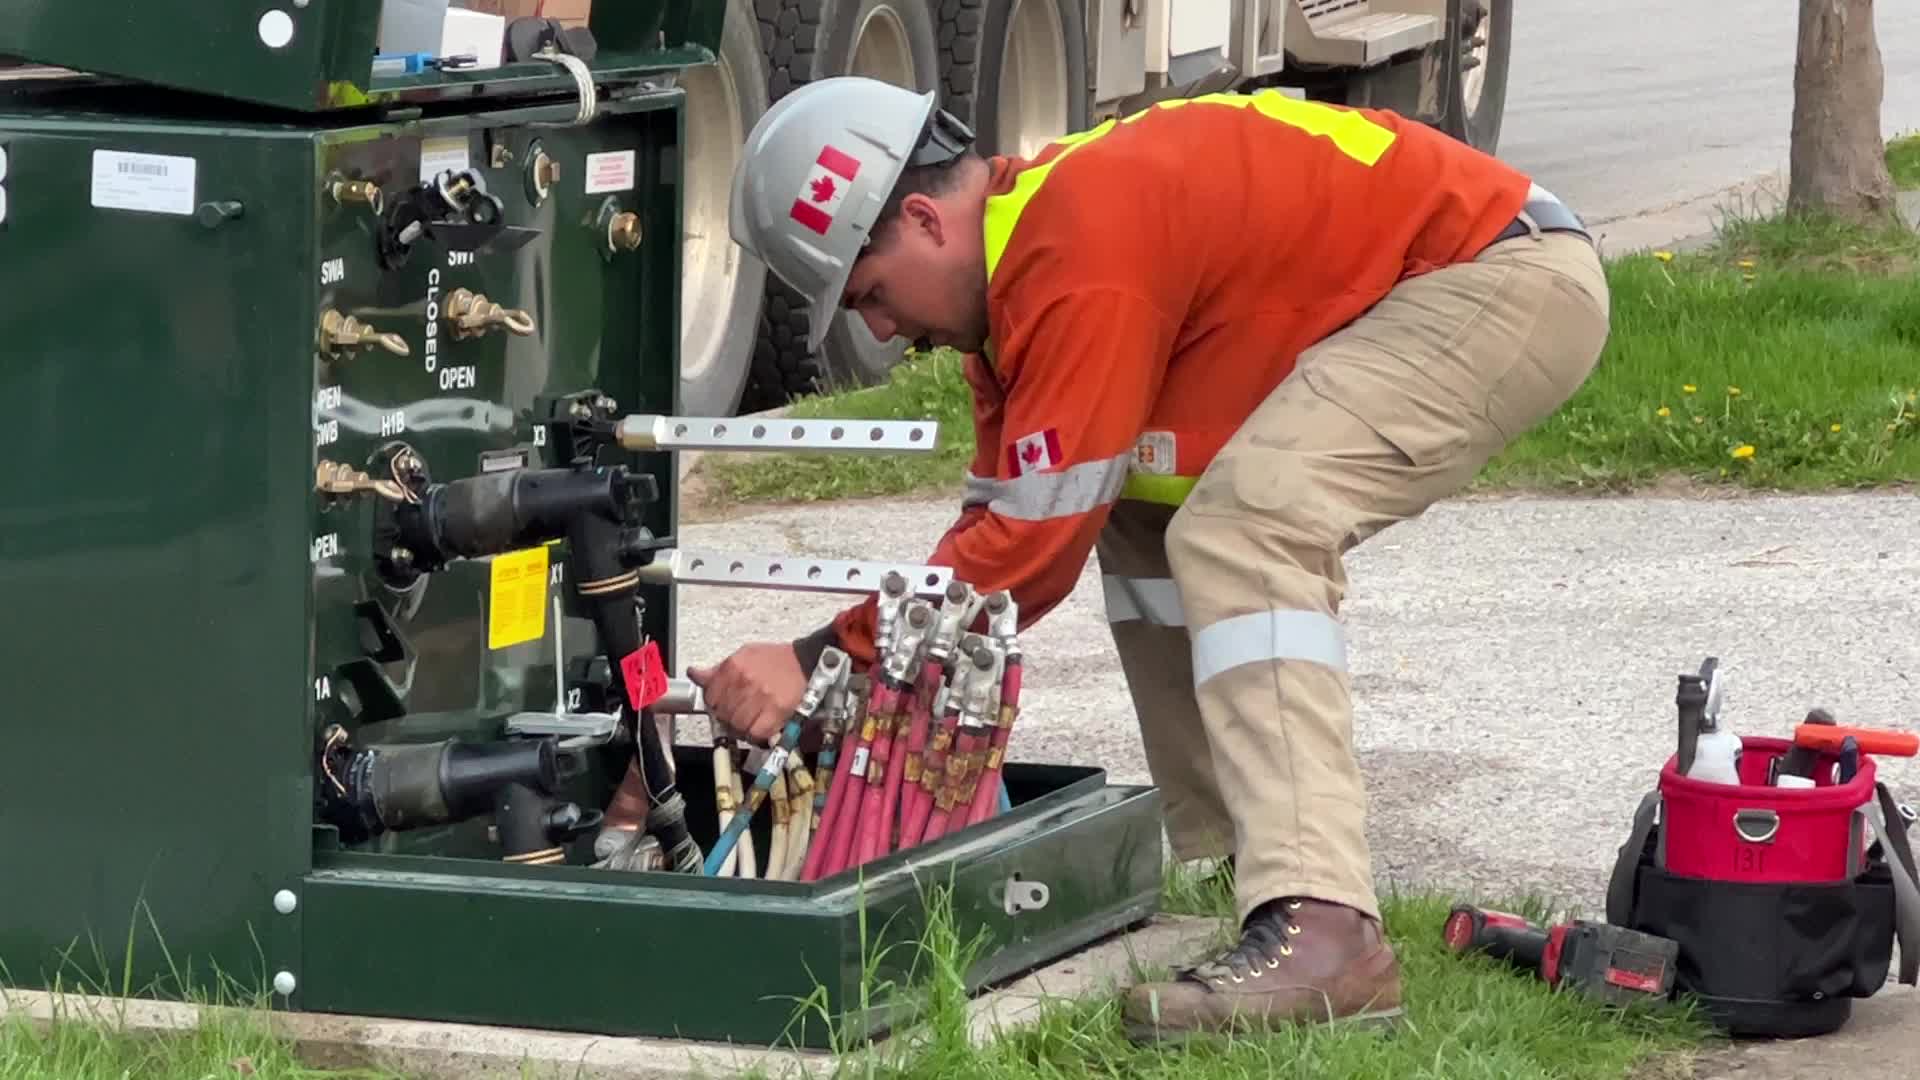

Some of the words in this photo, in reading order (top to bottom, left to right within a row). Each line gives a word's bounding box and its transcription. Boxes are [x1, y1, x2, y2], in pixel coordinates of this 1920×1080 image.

[321, 257, 344, 285] SWA
[425, 268, 440, 373] CLOSED
[440, 365, 476, 390] OPEN
[316, 385, 342, 411] PEN
[382, 410, 405, 437] H1B
[311, 532, 338, 561] PEN
